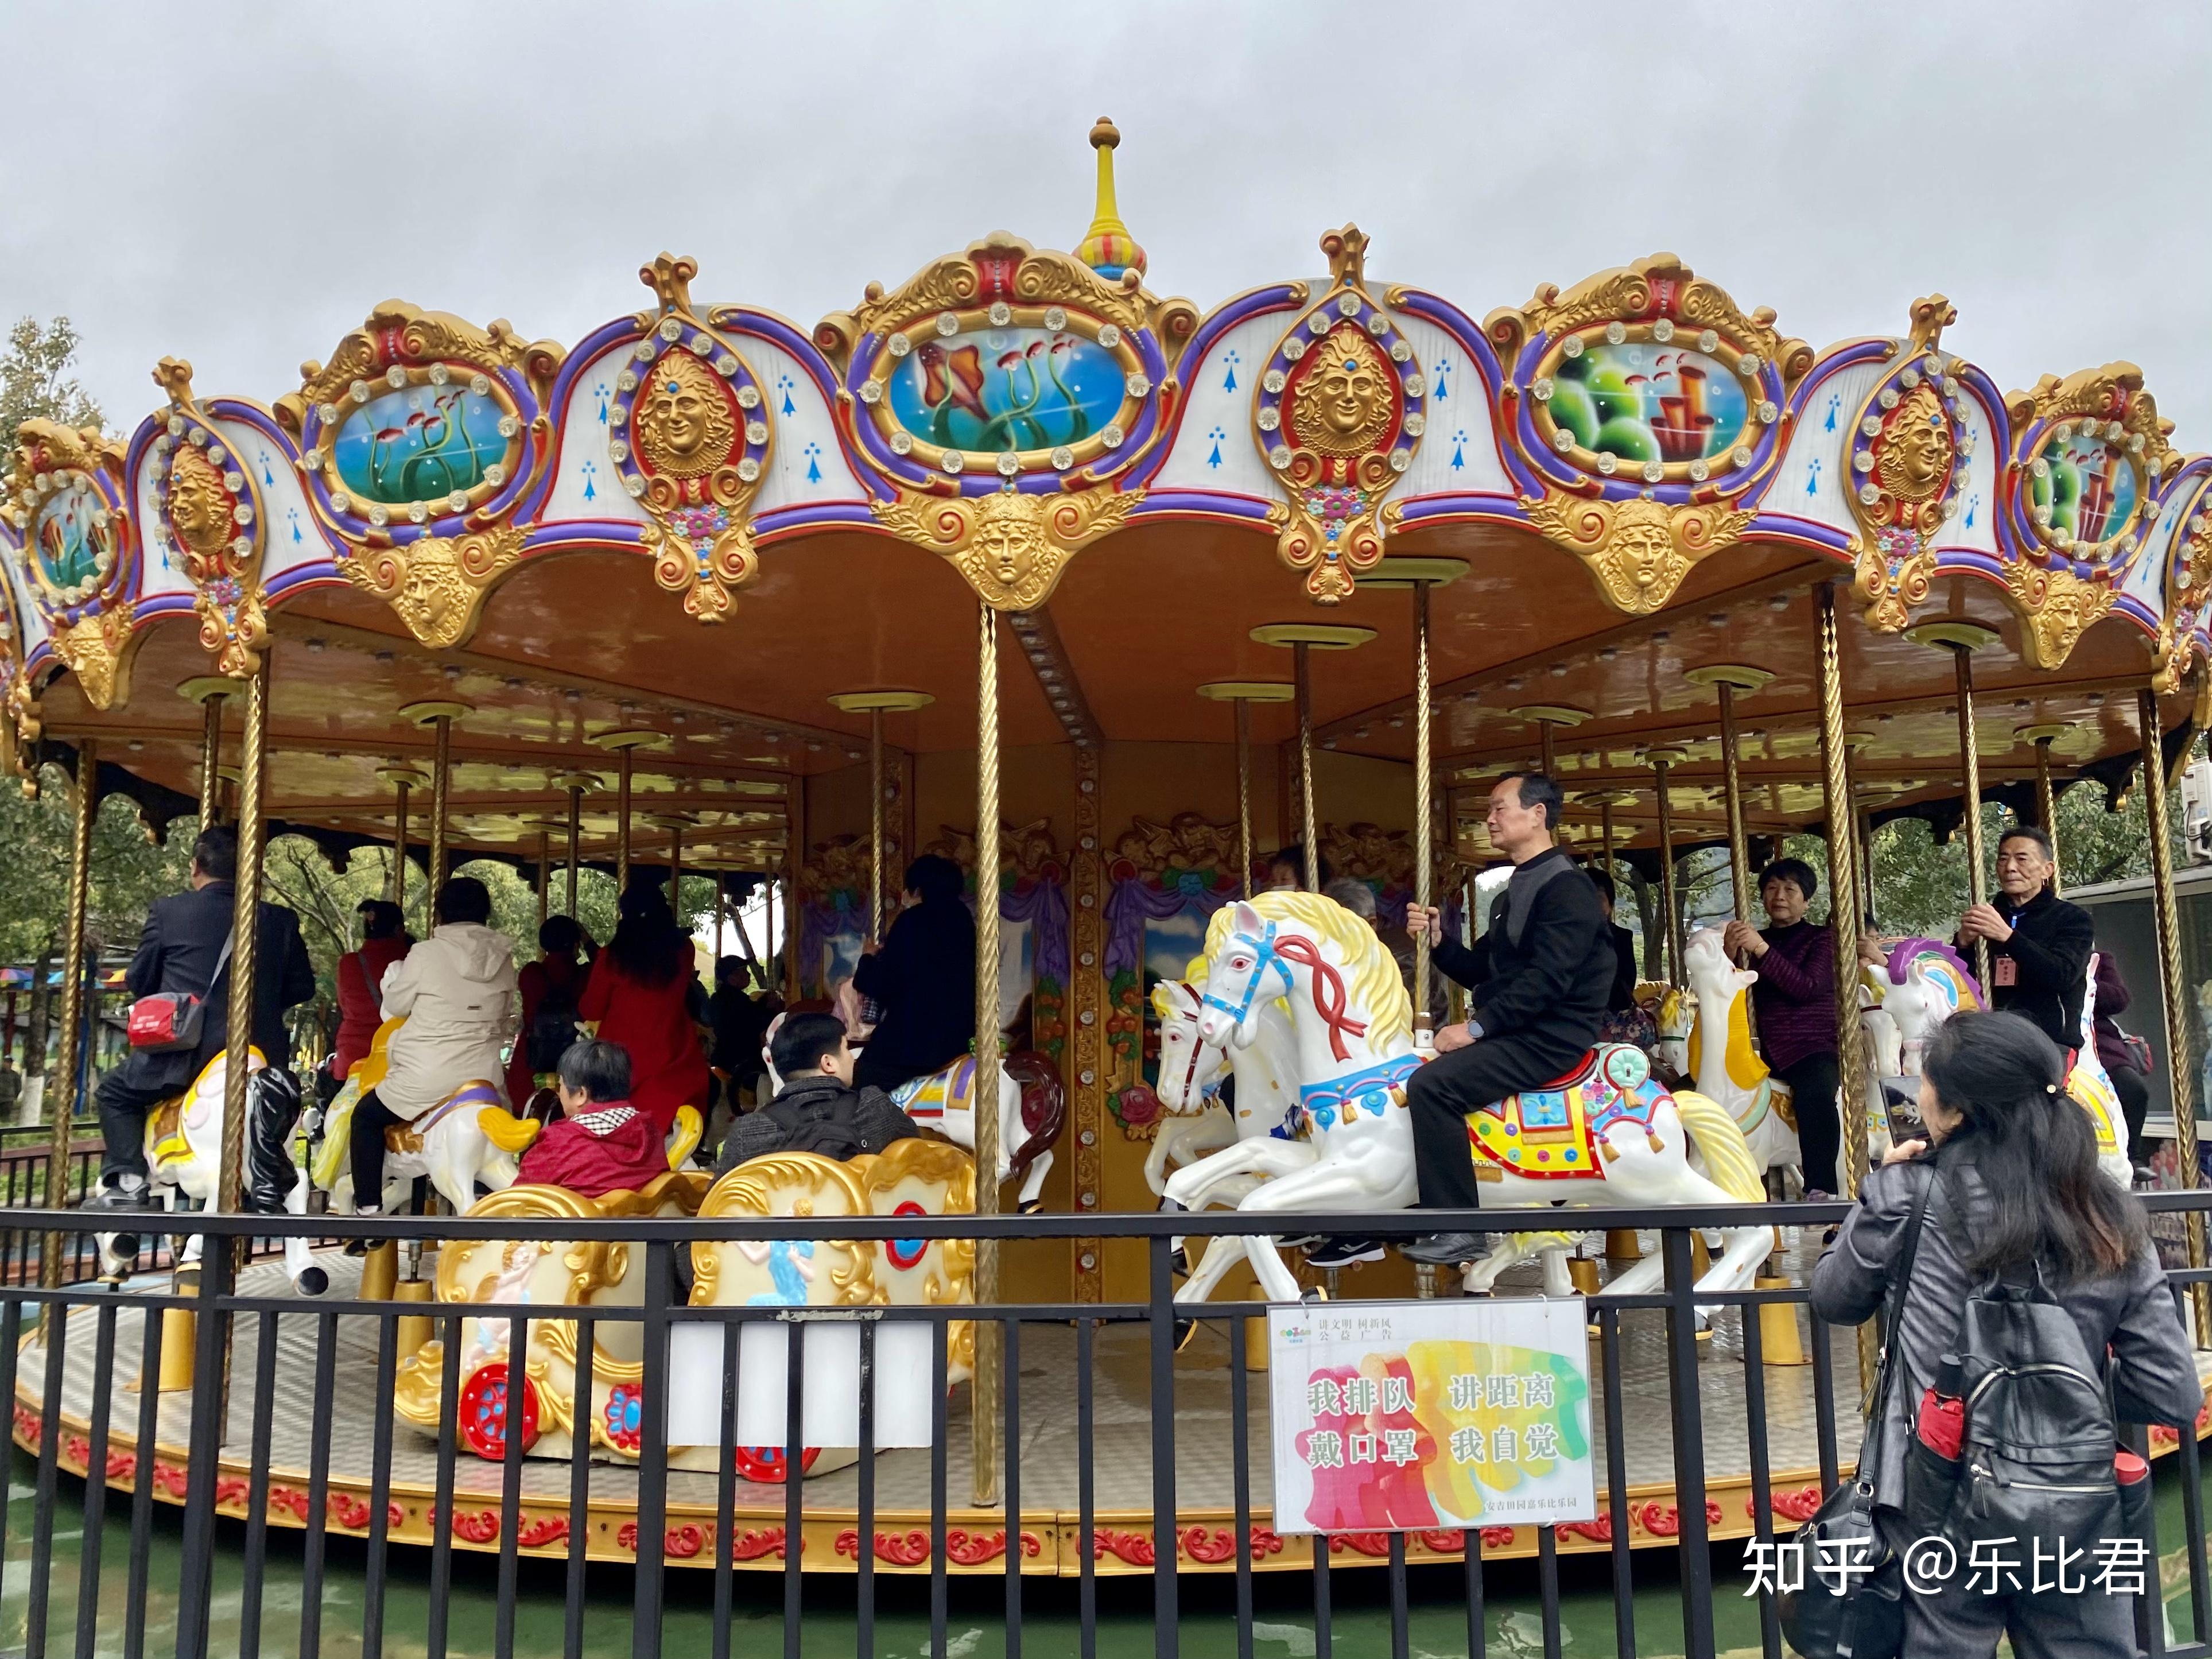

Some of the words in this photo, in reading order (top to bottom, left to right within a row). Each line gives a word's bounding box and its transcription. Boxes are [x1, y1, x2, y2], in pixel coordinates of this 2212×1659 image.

[1320, 1319, 1352, 1329] 讲文明
[1358, 1318, 1391, 1329] 树新风
[1320, 1329, 1392, 1341] 公益广告
[1308, 1378, 1415, 1415] 我排队
[1450, 1373, 1554, 1410] 讲距离
[1310, 1431, 1417, 1468] 戴口罩
[1451, 1425, 1558, 1462] 我自觉
[1486, 1497, 1577, 1511] 安吉田园嘉乐比乐园
